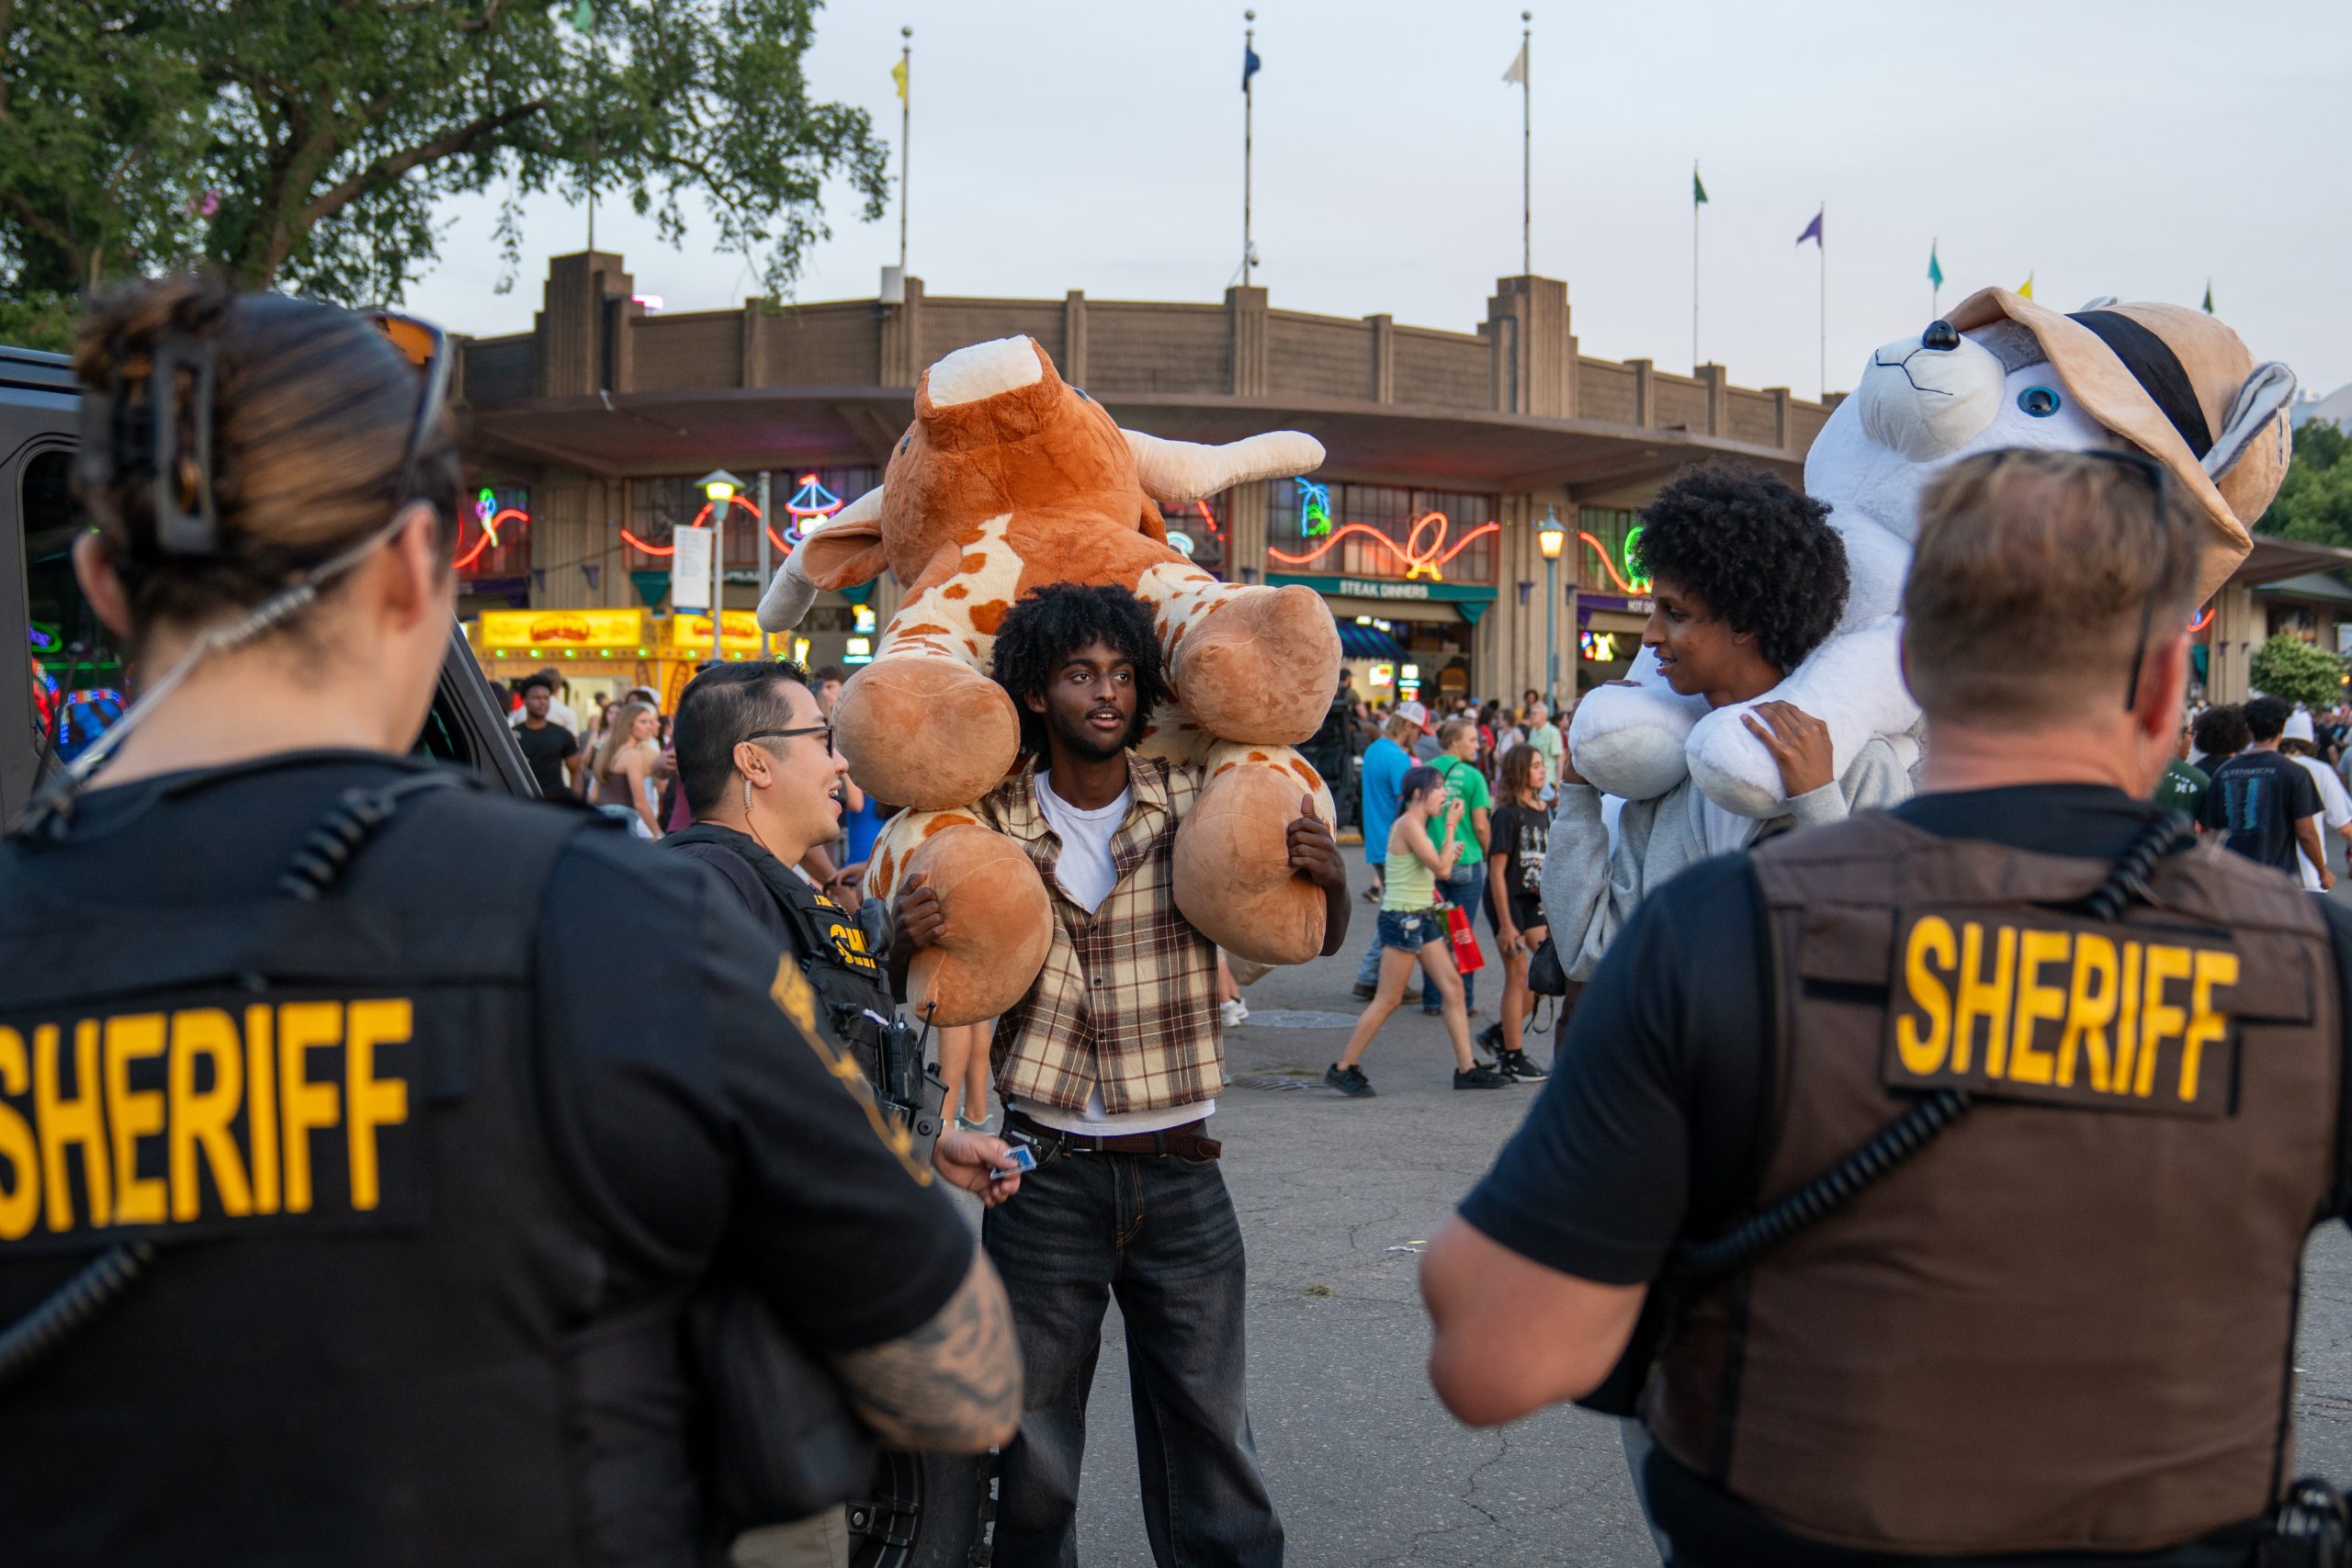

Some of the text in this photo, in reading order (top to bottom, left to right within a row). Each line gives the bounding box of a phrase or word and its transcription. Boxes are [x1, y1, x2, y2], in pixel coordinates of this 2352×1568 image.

[1340, 580, 1428, 599] STEAK DINNERS
[1896, 915, 2239, 1101] SHERIFF
